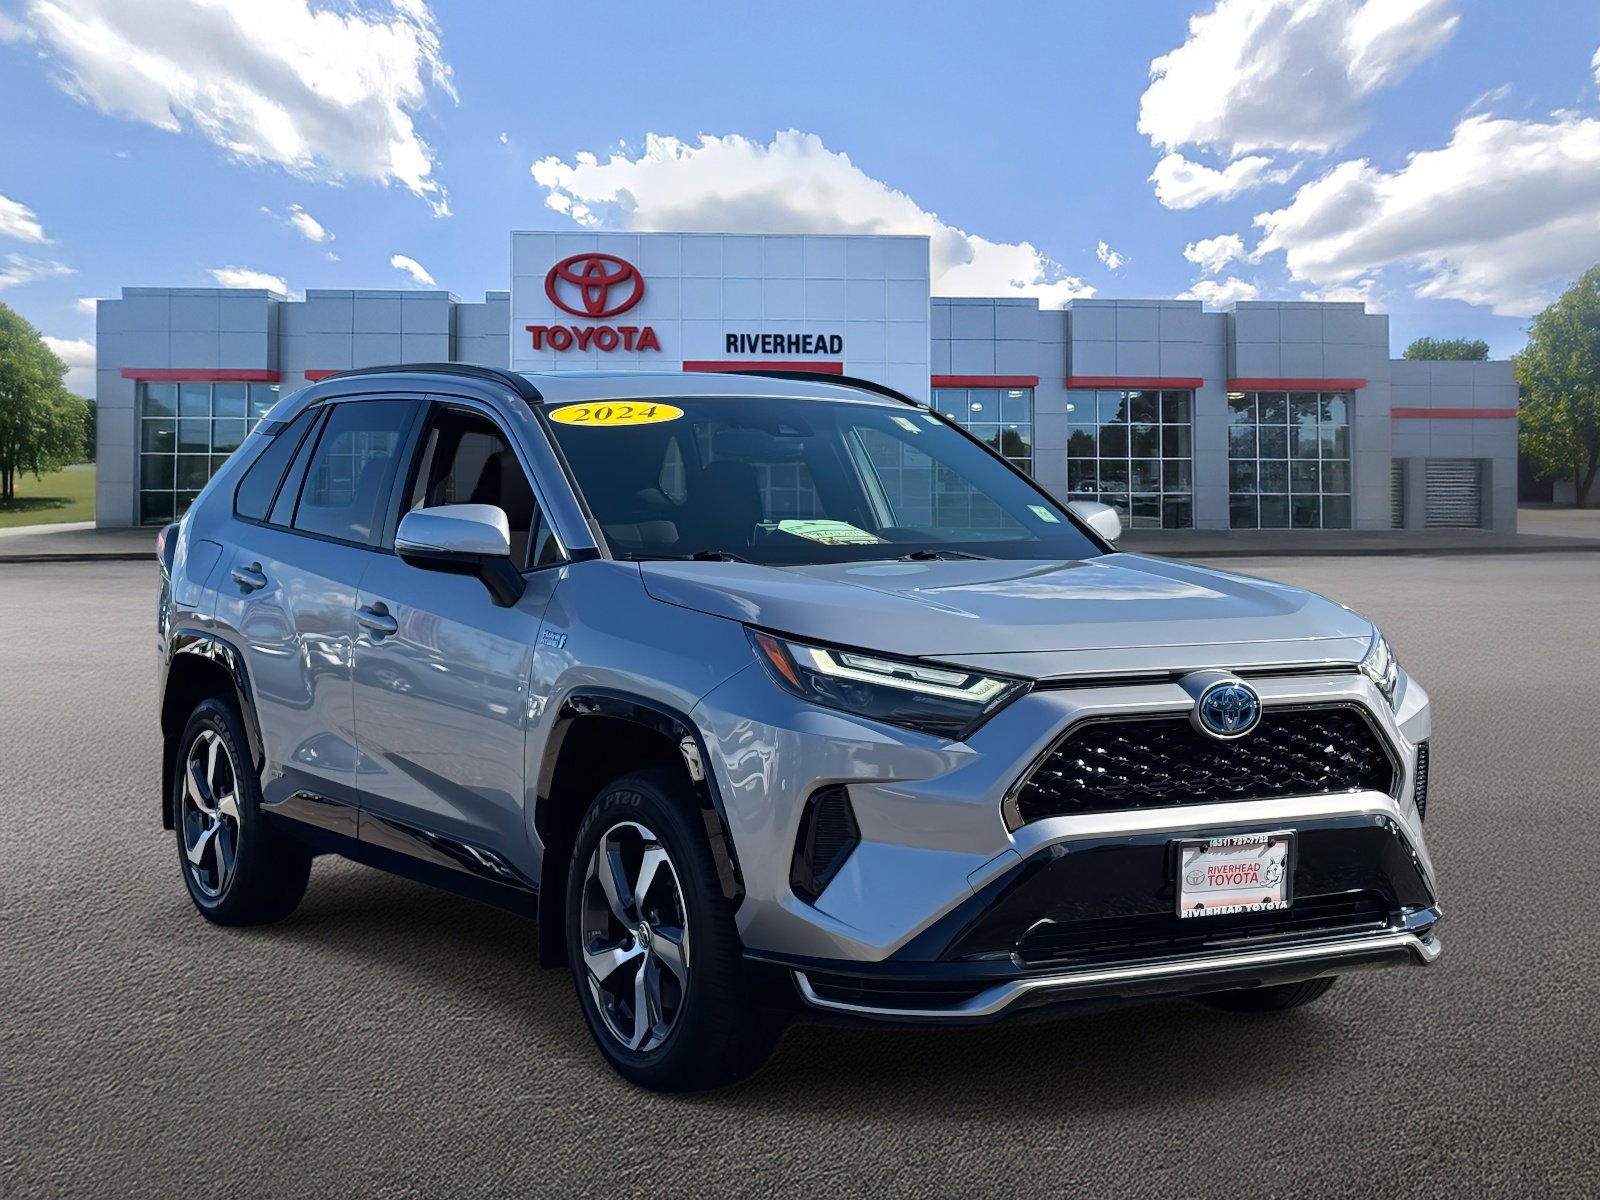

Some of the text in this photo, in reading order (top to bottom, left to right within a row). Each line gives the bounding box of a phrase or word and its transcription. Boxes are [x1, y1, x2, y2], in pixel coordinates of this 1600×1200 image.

[526, 326, 661, 352] TOYOTA
[726, 333, 844, 354] RIVERHEAD
[573, 405, 657, 423] 2024
[1208, 863, 1261, 874] RIVERHEAD
[1208, 874, 1258, 886] TOYOTA
[1182, 901, 1288, 918] RIVERHEAD TOYOTA
